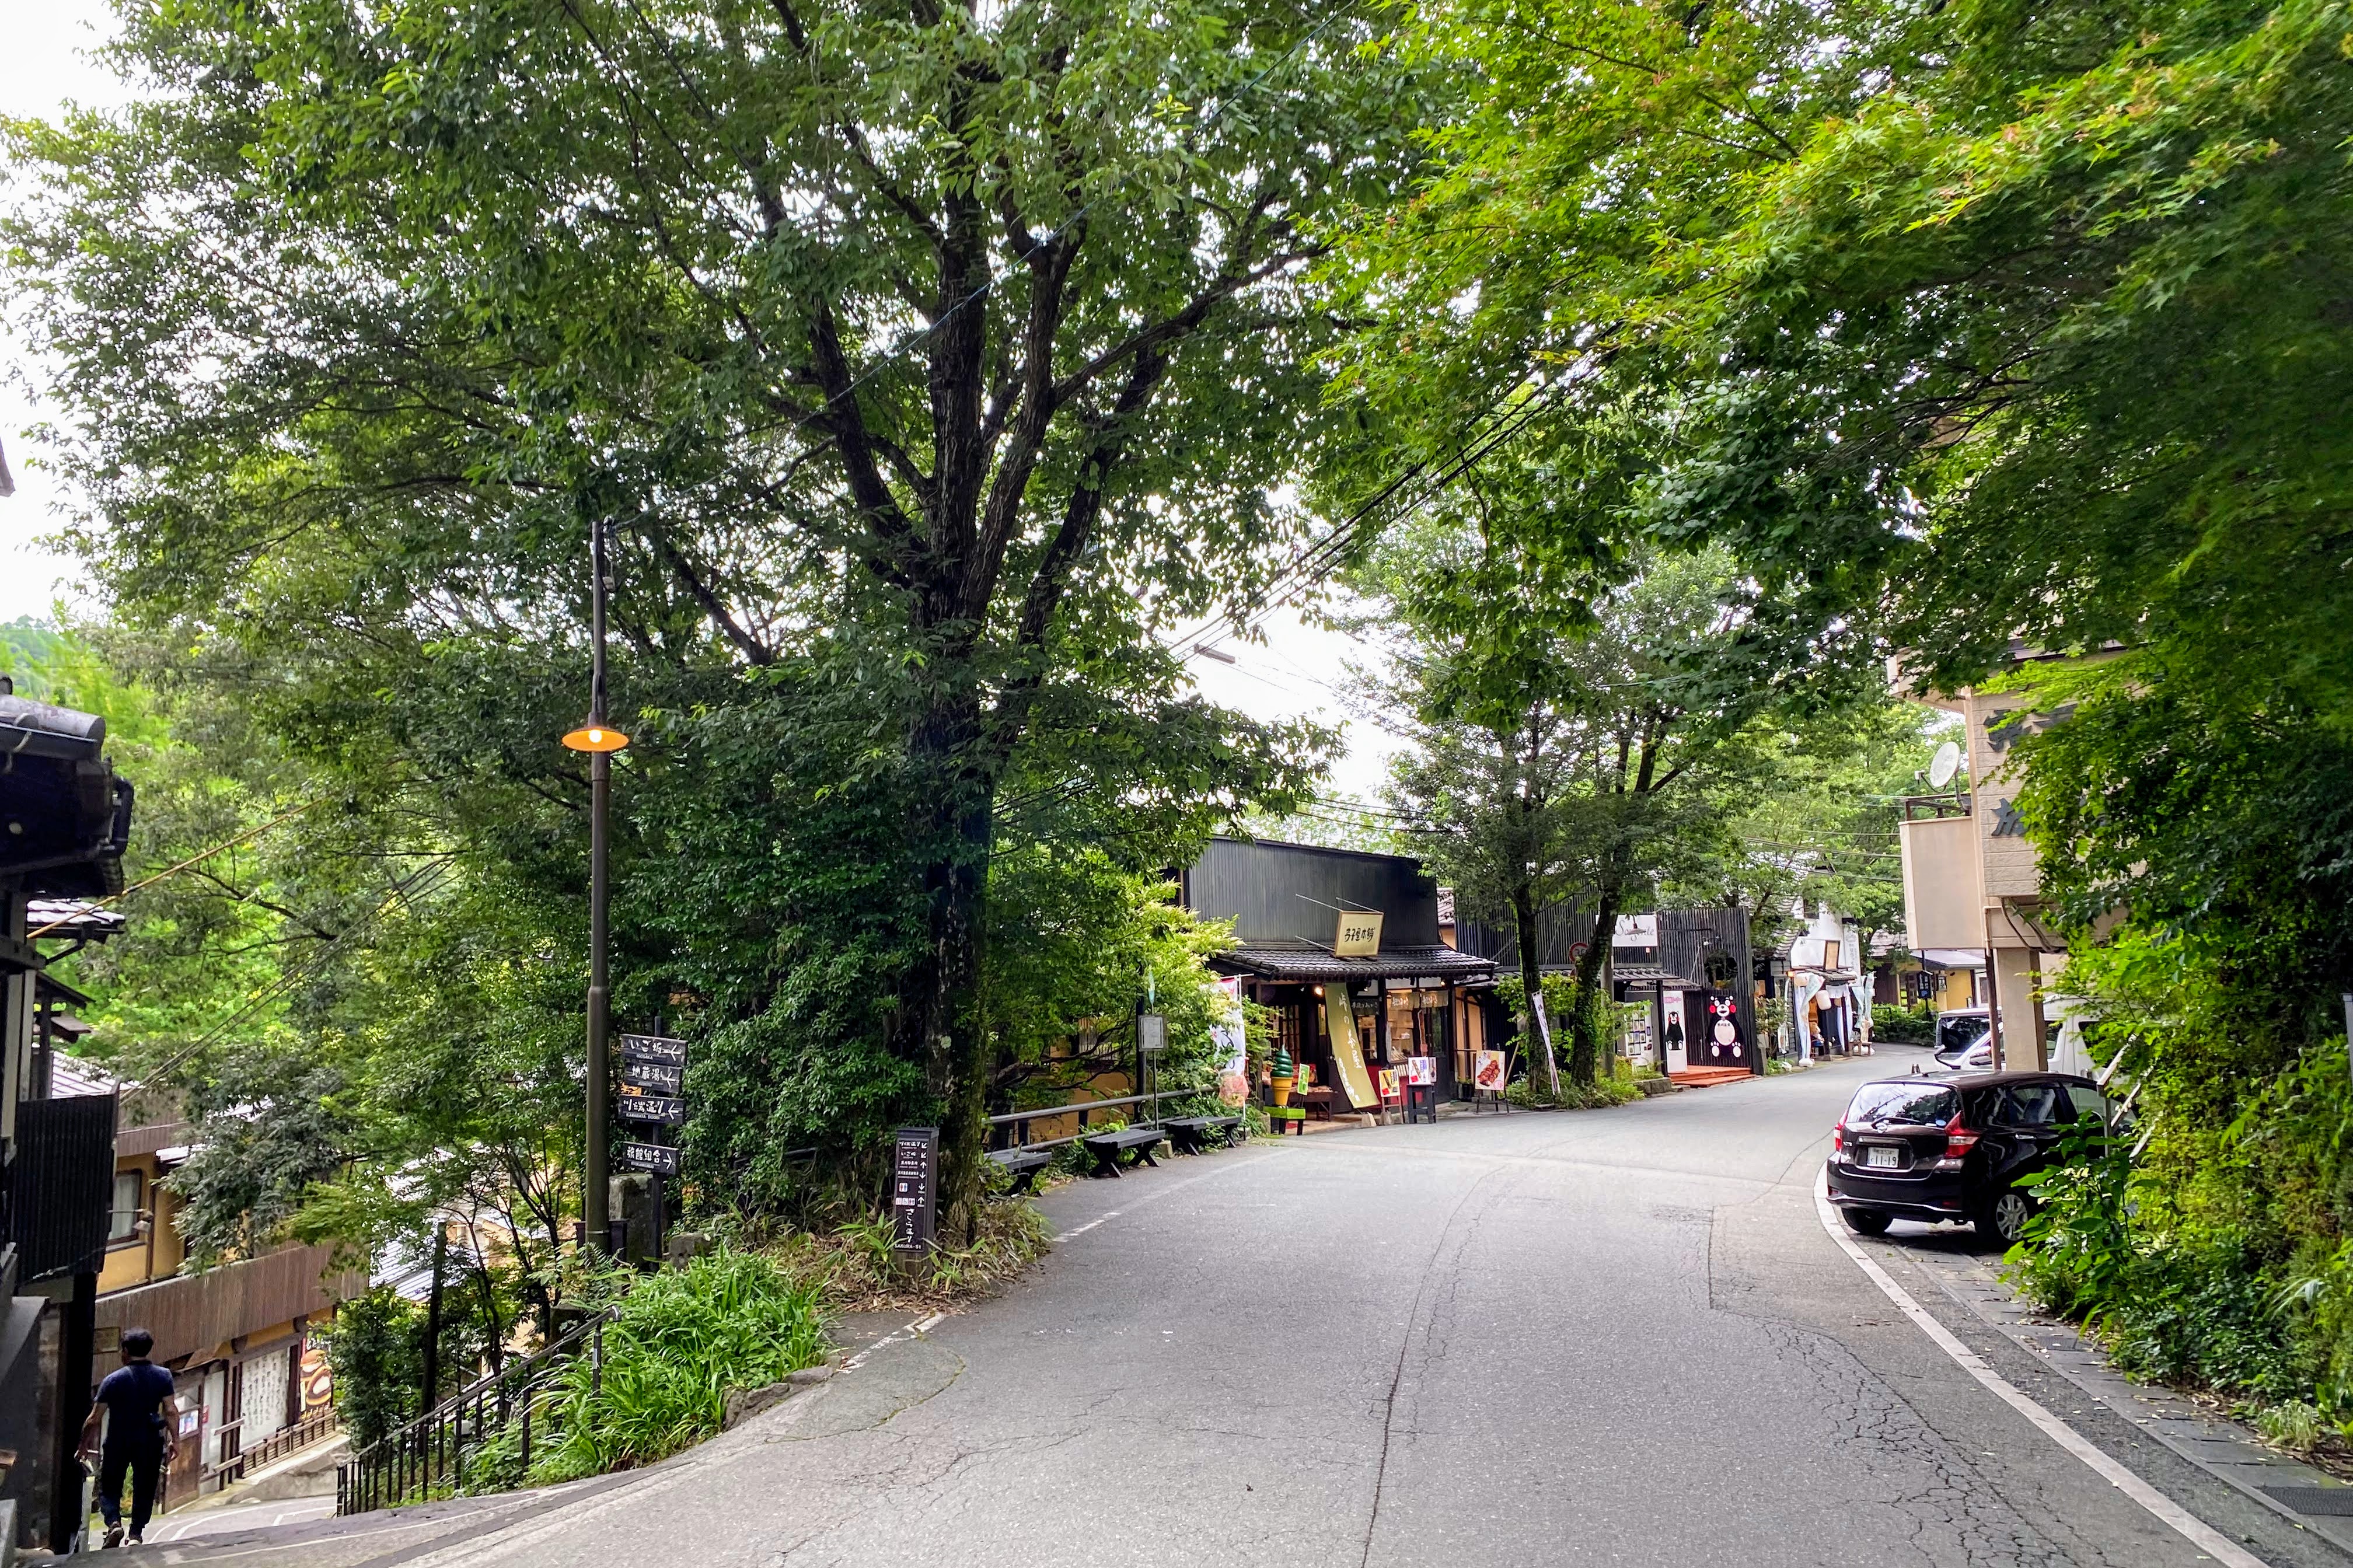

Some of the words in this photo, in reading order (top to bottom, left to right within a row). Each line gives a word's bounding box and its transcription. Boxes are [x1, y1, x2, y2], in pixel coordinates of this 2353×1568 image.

[629, 1039, 662, 1055] いご坂
[632, 1065, 659, 1081] 地蔵湯
[623, 1099, 664, 1114] 川端通り
[627, 1146, 661, 1163] 旅館組合
[1876, 1155, 1897, 1165] 11-19
[905, 1209, 914, 1243] さくら通り
